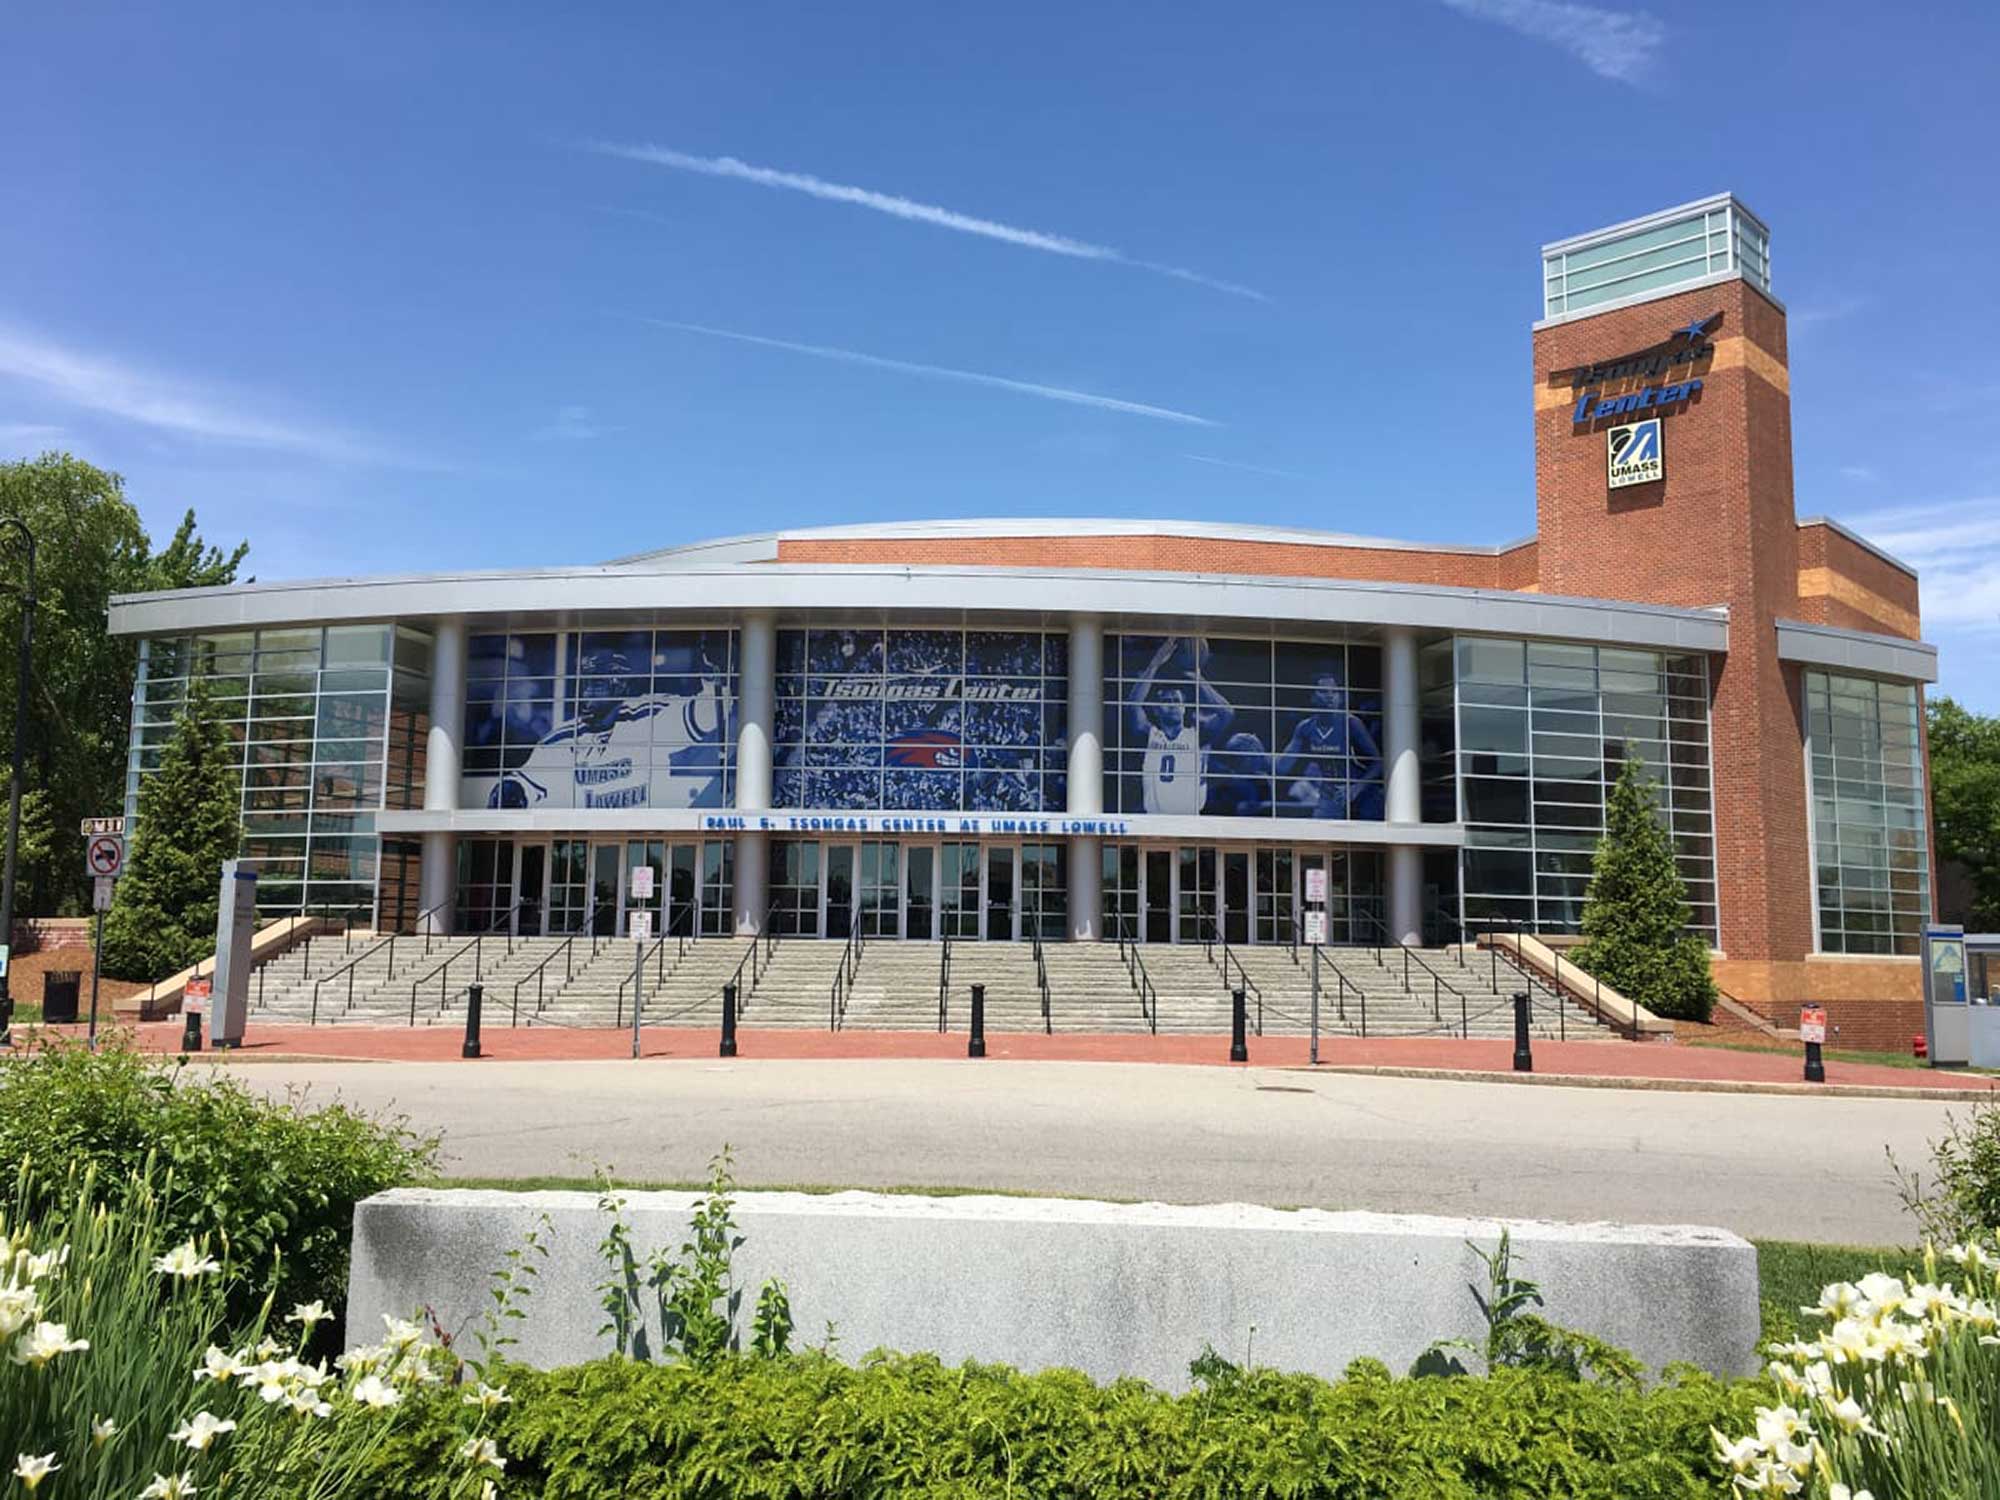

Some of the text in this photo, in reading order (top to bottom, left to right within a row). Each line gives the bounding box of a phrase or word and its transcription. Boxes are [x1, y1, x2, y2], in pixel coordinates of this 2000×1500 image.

[1572, 376, 1704, 423] Center
[1611, 460, 1659, 478] UMASS
[1611, 471, 1660, 485] LOWELL
[823, 677, 1043, 702] Tsongas Center
[574, 757, 633, 785] UMASS
[706, 817, 746, 829] PAUL
[789, 817, 868, 830] TSONGAS
[881, 818, 945, 831] CENTER
[960, 819, 980, 832] AT
[991, 820, 1049, 832] UMASS
[1061, 821, 1128, 834] LOWELL
